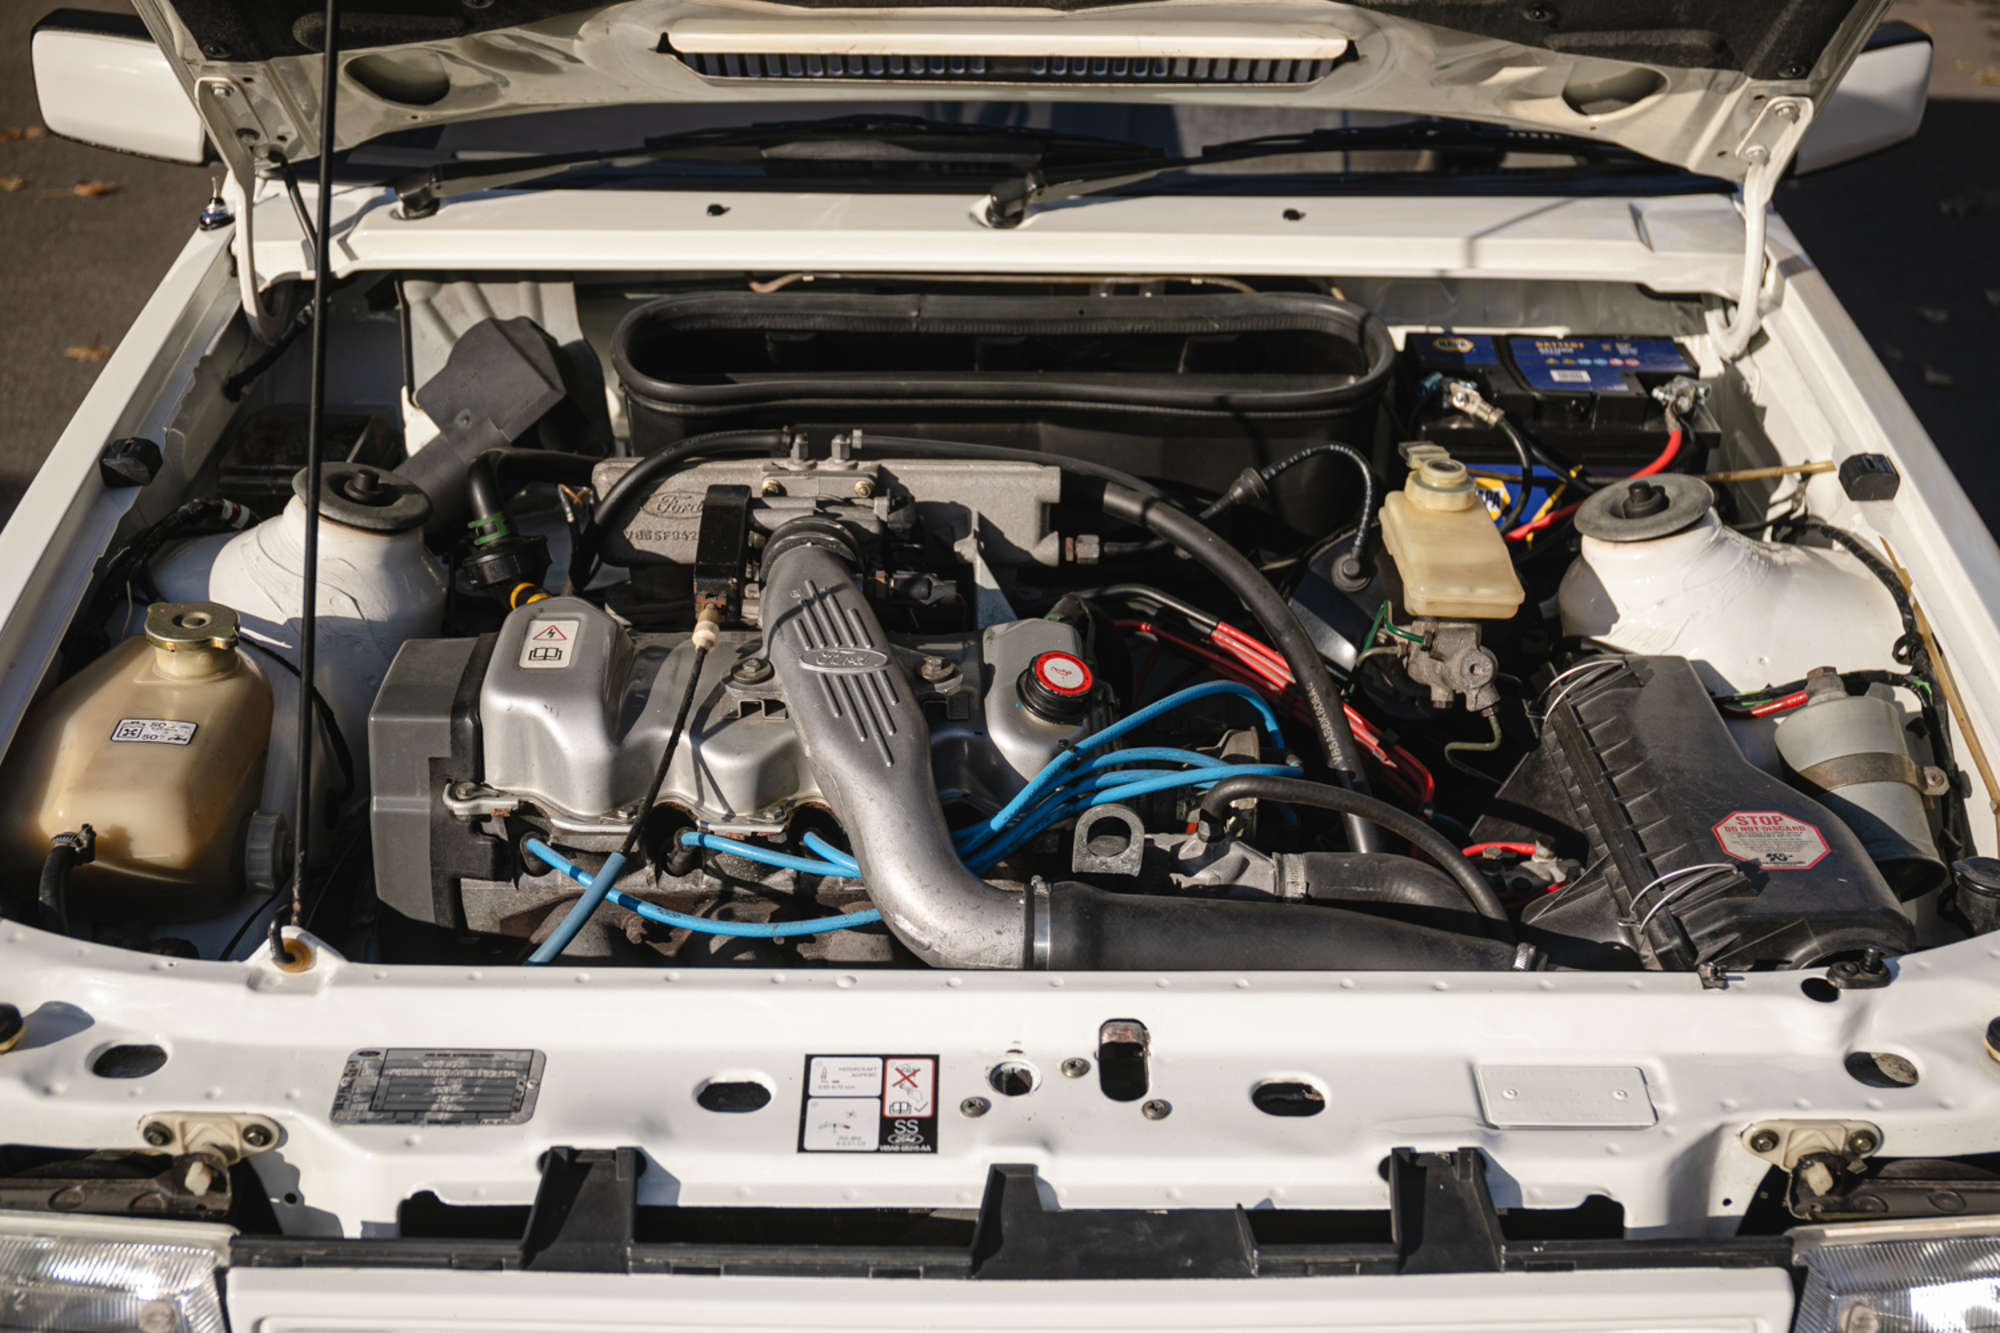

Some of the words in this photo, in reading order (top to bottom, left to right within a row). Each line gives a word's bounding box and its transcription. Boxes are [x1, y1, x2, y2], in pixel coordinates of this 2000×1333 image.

[657, 494, 704, 514] Ford
[815, 649, 871, 667] Ford
[1735, 815, 1784, 826] STOP
[893, 1118, 919, 1135] SS
